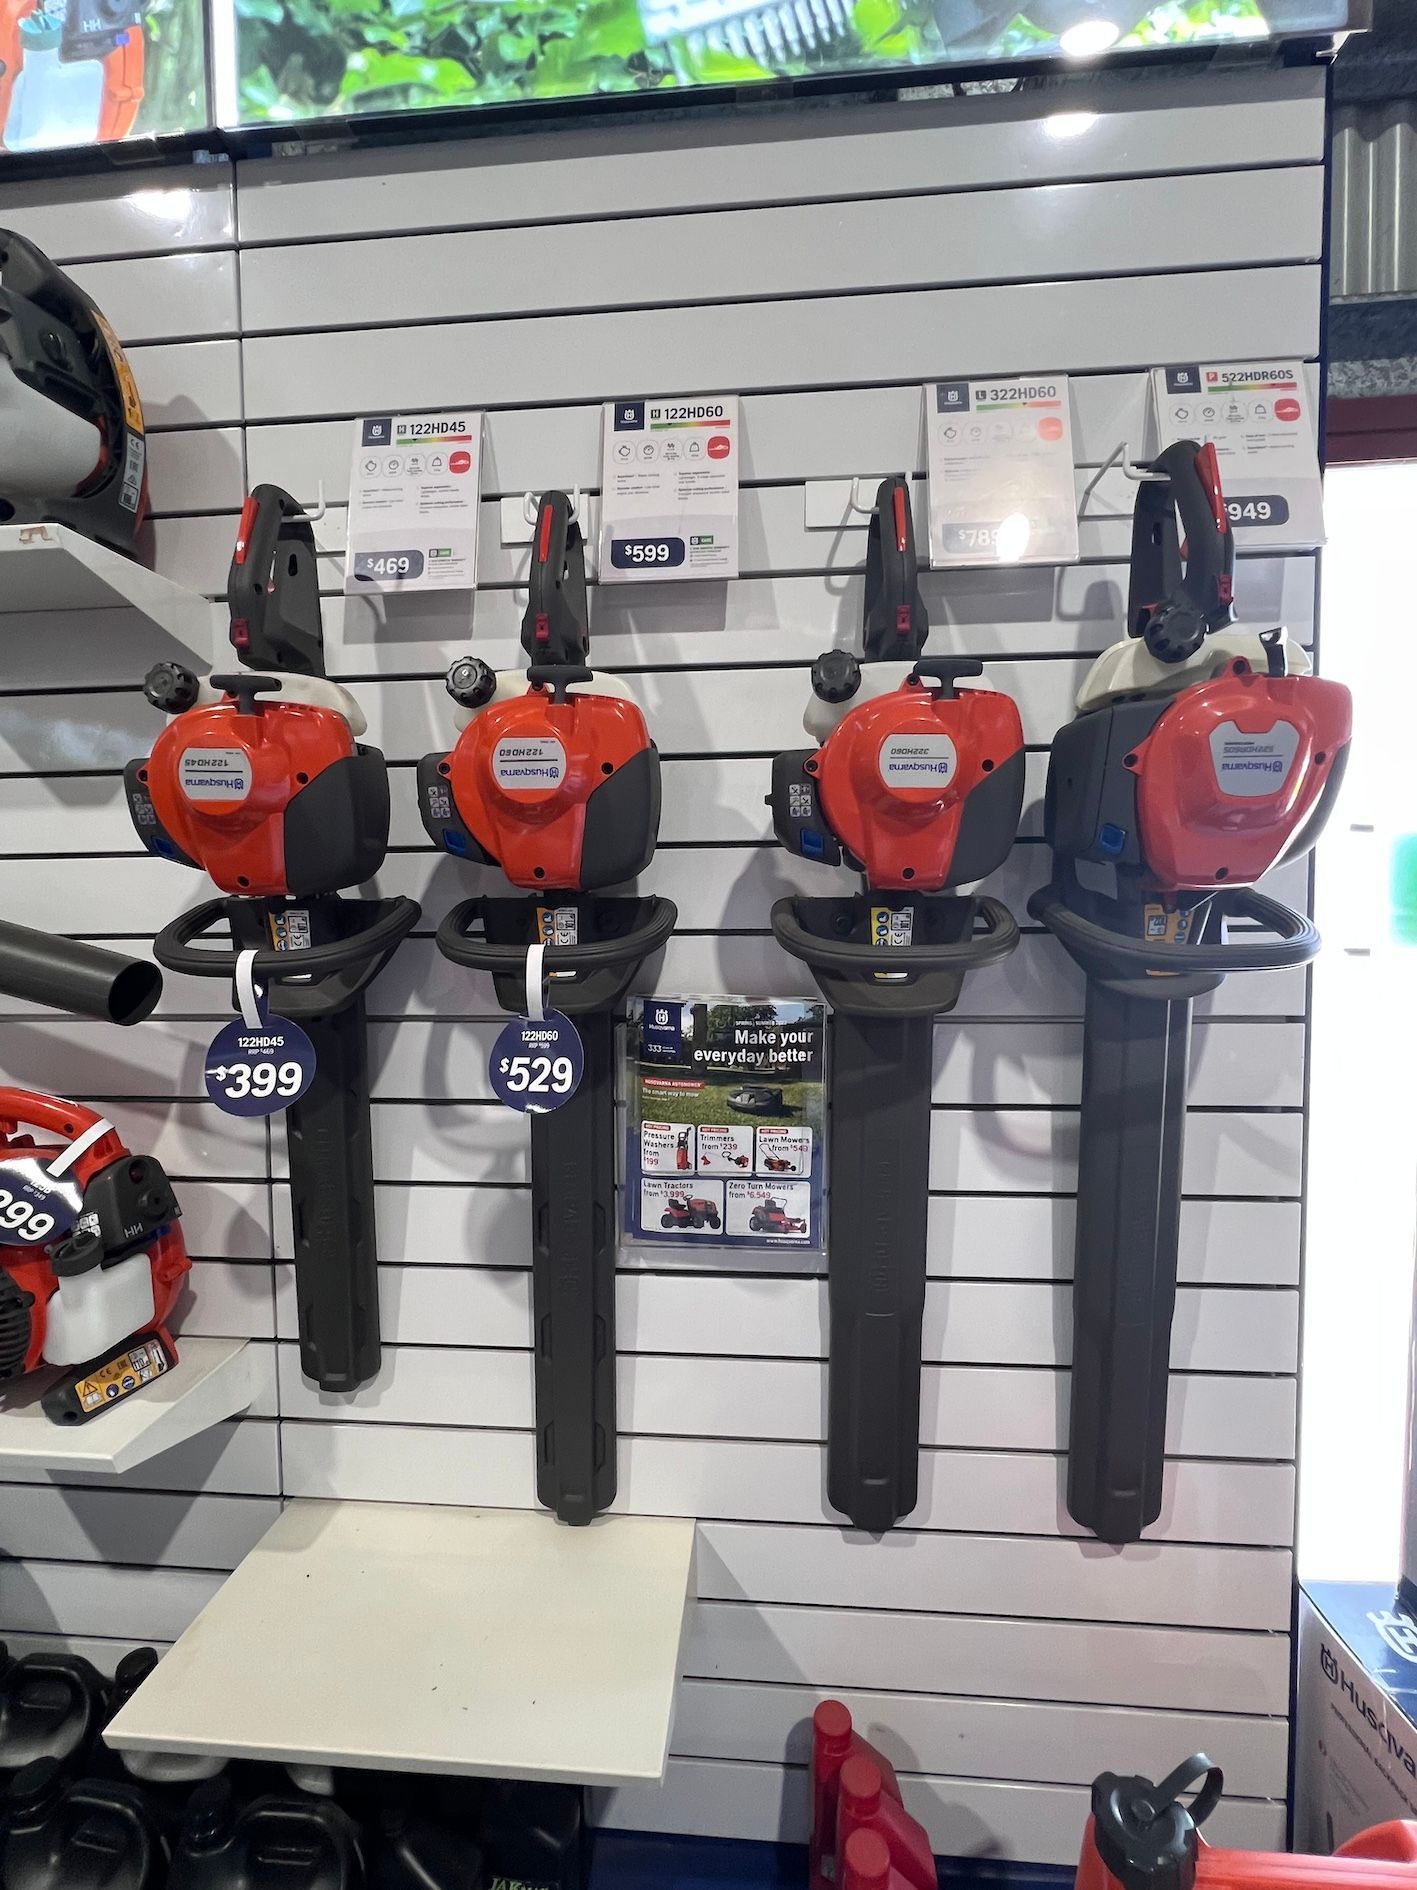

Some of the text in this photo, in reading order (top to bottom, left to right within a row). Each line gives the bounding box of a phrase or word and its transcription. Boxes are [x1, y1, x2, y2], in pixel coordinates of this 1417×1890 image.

[1222, 370, 1293, 382] 522HDR60S
[990, 386, 1056, 401] 322HD60
[664, 405, 723, 420] 122HD60
[410, 421, 466, 435] 122HD45
[624, 544, 670, 563] $599
[367, 557, 409, 574] $469
[500, 767, 549, 777] Husqvarna
[888, 762, 938, 772] Husqvarna
[185, 778, 233, 788] Husqvarna
[521, 1030, 559, 1042] 122HD60
[735, 1029, 814, 1047] Make your
[238, 1036, 285, 1048] 122HD45
[694, 1048, 764, 1067] everyday
[769, 1048, 813, 1063] better
[499, 1056, 574, 1093] $529
[215, 1062, 303, 1099] $399
[644, 1130, 675, 1140] Pressure
[700, 1134, 734, 1142] Trimmers
[780, 1136, 810, 1144] Mowers
[644, 1140, 674, 1148] Washers
[643, 1148, 659, 1157] from
[643, 1180, 662, 1188] Lawn
[729, 1182, 794, 1191] Zero Turn Mowers
[643, 1189, 660, 1197] from
[729, 1191, 746, 1199] from
